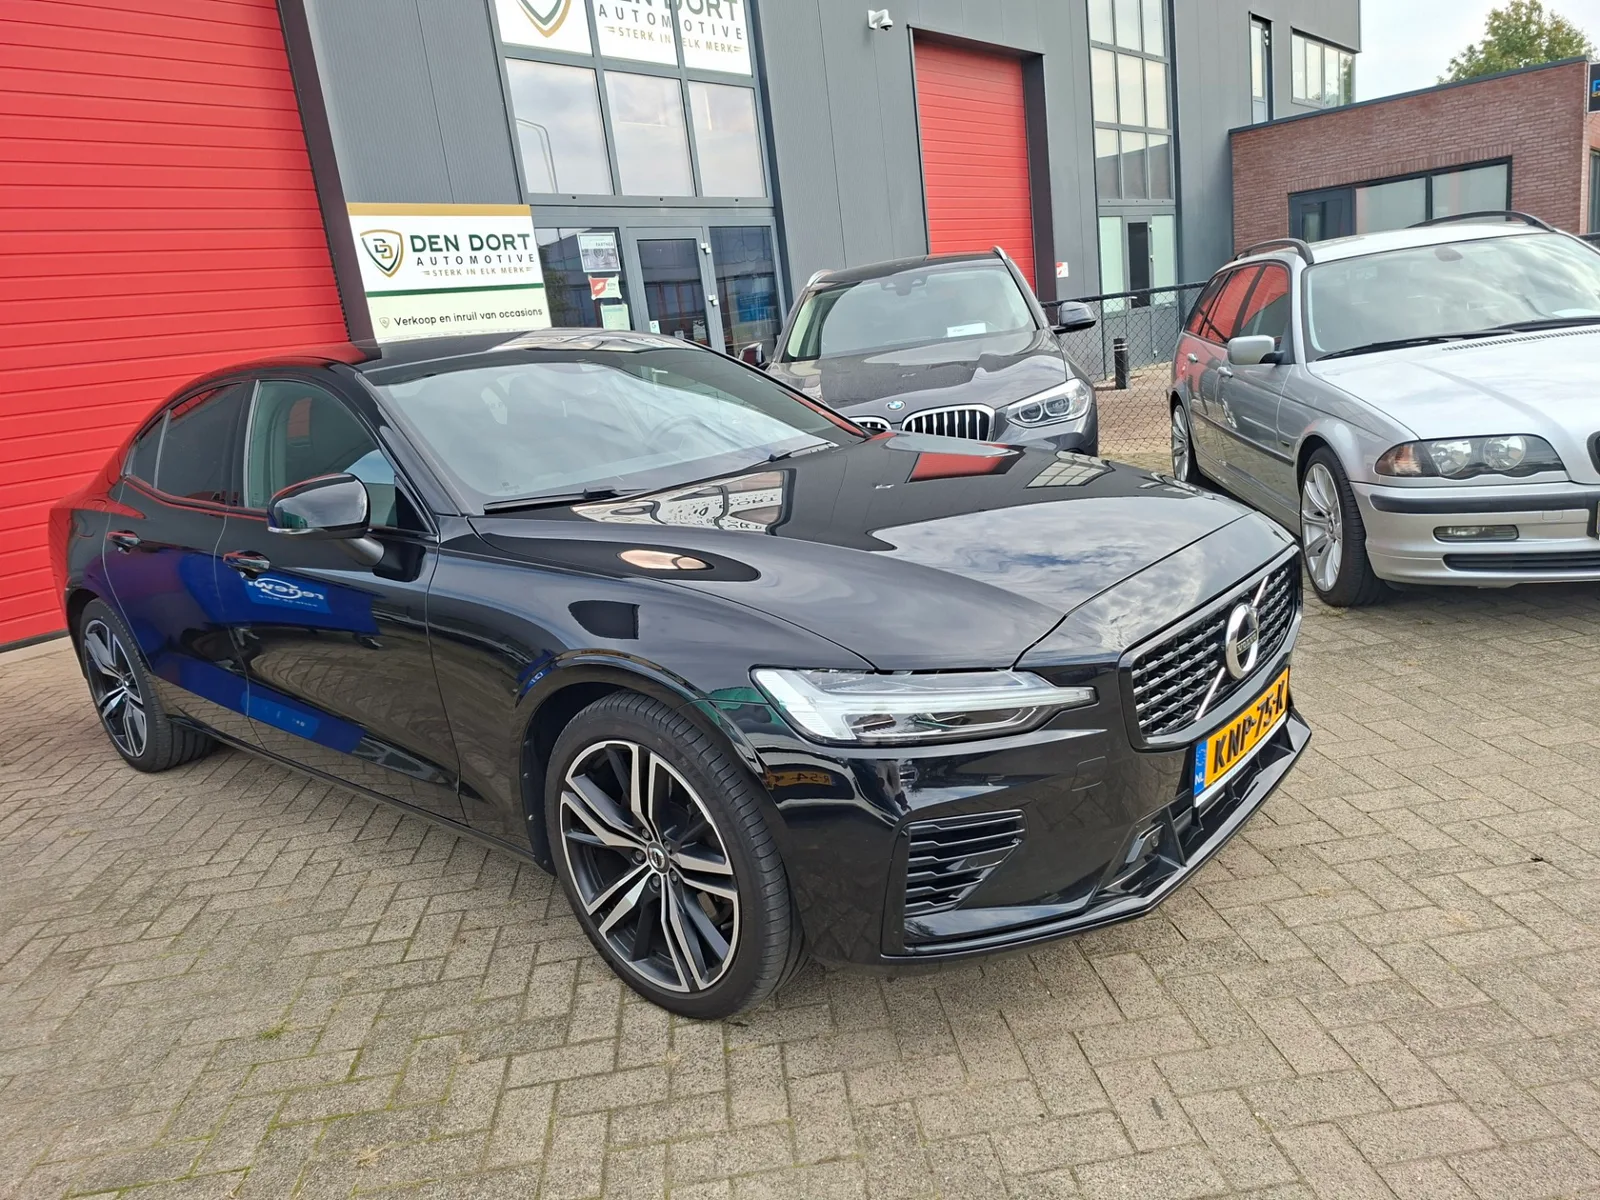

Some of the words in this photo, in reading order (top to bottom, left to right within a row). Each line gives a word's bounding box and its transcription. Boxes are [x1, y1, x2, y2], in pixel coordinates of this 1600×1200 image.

[598, 3, 742, 40] AUTOMOTIVE
[618, 27, 655, 42] STERK
[660, 33, 671, 44] IN
[682, 37, 700, 48] ELK
[706, 41, 733, 53] MERK
[409, 234, 460, 253] DEN
[468, 233, 531, 252] DORT
[416, 253, 535, 267] AUTOMOTIVE
[432, 268, 462, 277] STERK
[480, 267, 496, 275] ELK
[500, 266, 525, 274] MERK
[394, 313, 437, 328] Verkoop
[439, 315, 451, 323] en
[453, 309, 478, 322] inruil
[479, 311, 497, 320] van
[499, 307, 543, 319] occasions
[1213, 680, 1285, 774] KNP-75-K
[1194, 771, 1205, 786] NL
